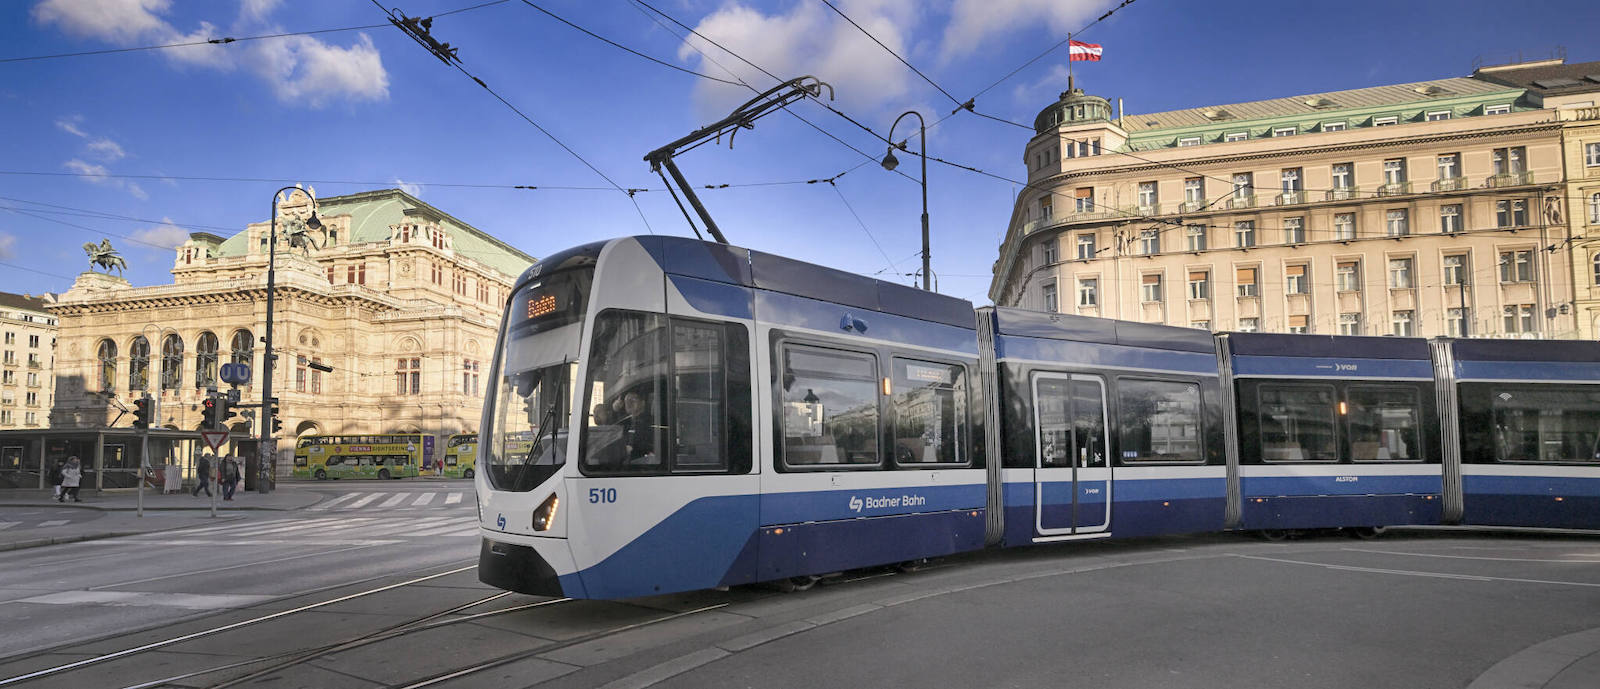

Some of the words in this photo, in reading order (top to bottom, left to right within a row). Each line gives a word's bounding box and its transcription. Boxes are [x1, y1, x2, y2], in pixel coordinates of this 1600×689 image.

[528, 264, 543, 280] 510
[528, 295, 556, 319] Baden
[237, 366, 249, 380] U
[589, 487, 617, 504] 510
[865, 495, 901, 509] Badner
[902, 494, 926, 507] Bahn
